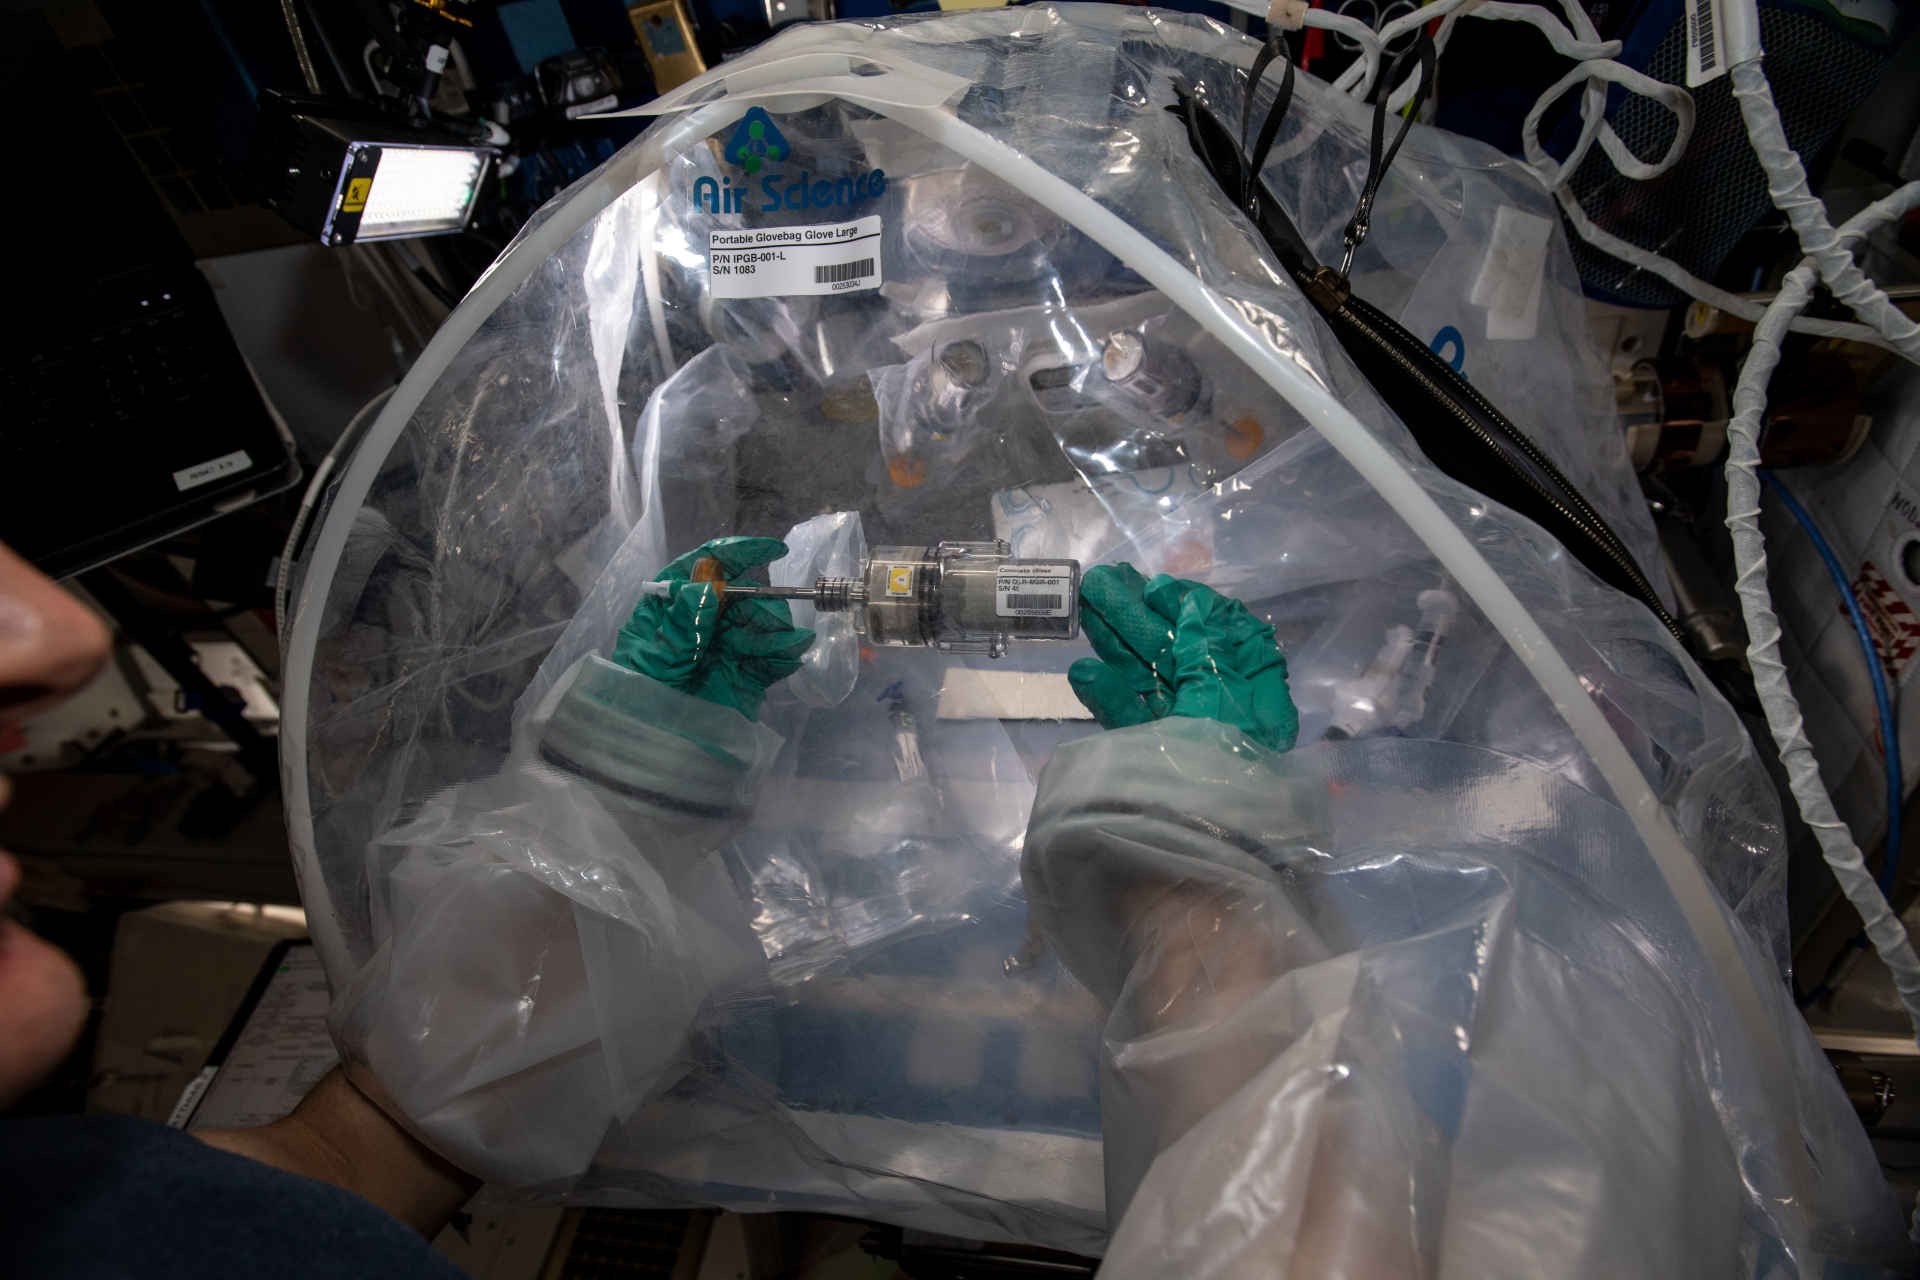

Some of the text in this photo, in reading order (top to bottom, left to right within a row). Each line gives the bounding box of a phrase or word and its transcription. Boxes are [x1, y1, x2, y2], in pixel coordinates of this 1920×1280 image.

[693, 168, 887, 214] Air Science
[711, 226, 858, 245] Portable Glovebag Glove Large
[712, 251, 787, 264] P/N IPGB-001-L
[712, 264, 757, 275] S/N 1083
